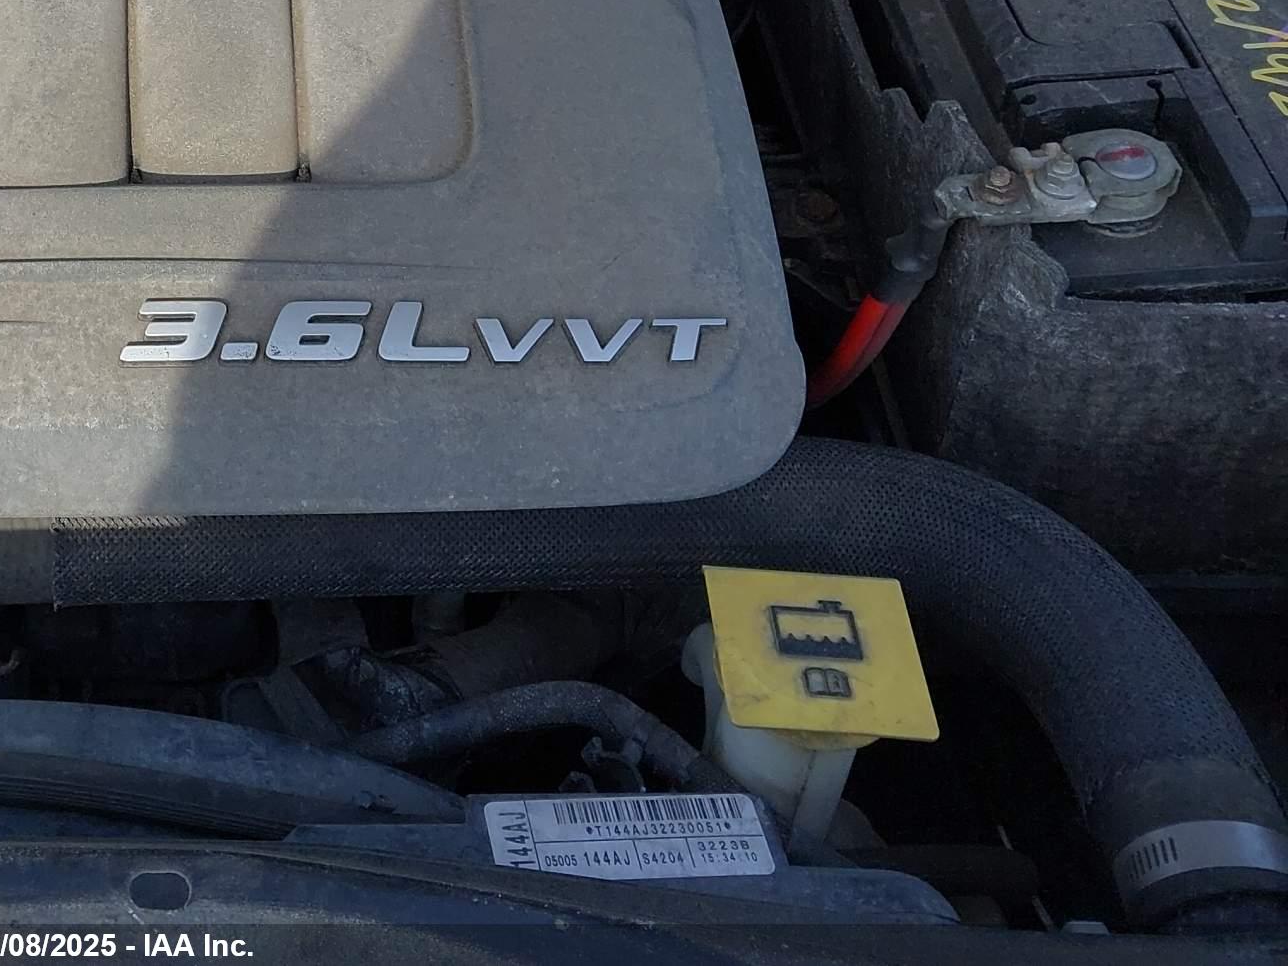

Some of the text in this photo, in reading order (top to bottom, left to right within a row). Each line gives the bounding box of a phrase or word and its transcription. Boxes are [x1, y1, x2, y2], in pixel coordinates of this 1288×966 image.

[498, 812, 536, 865] 144AJ
[545, 850, 630, 867] 05005 144AJ
[642, 852, 684, 865] S4204
